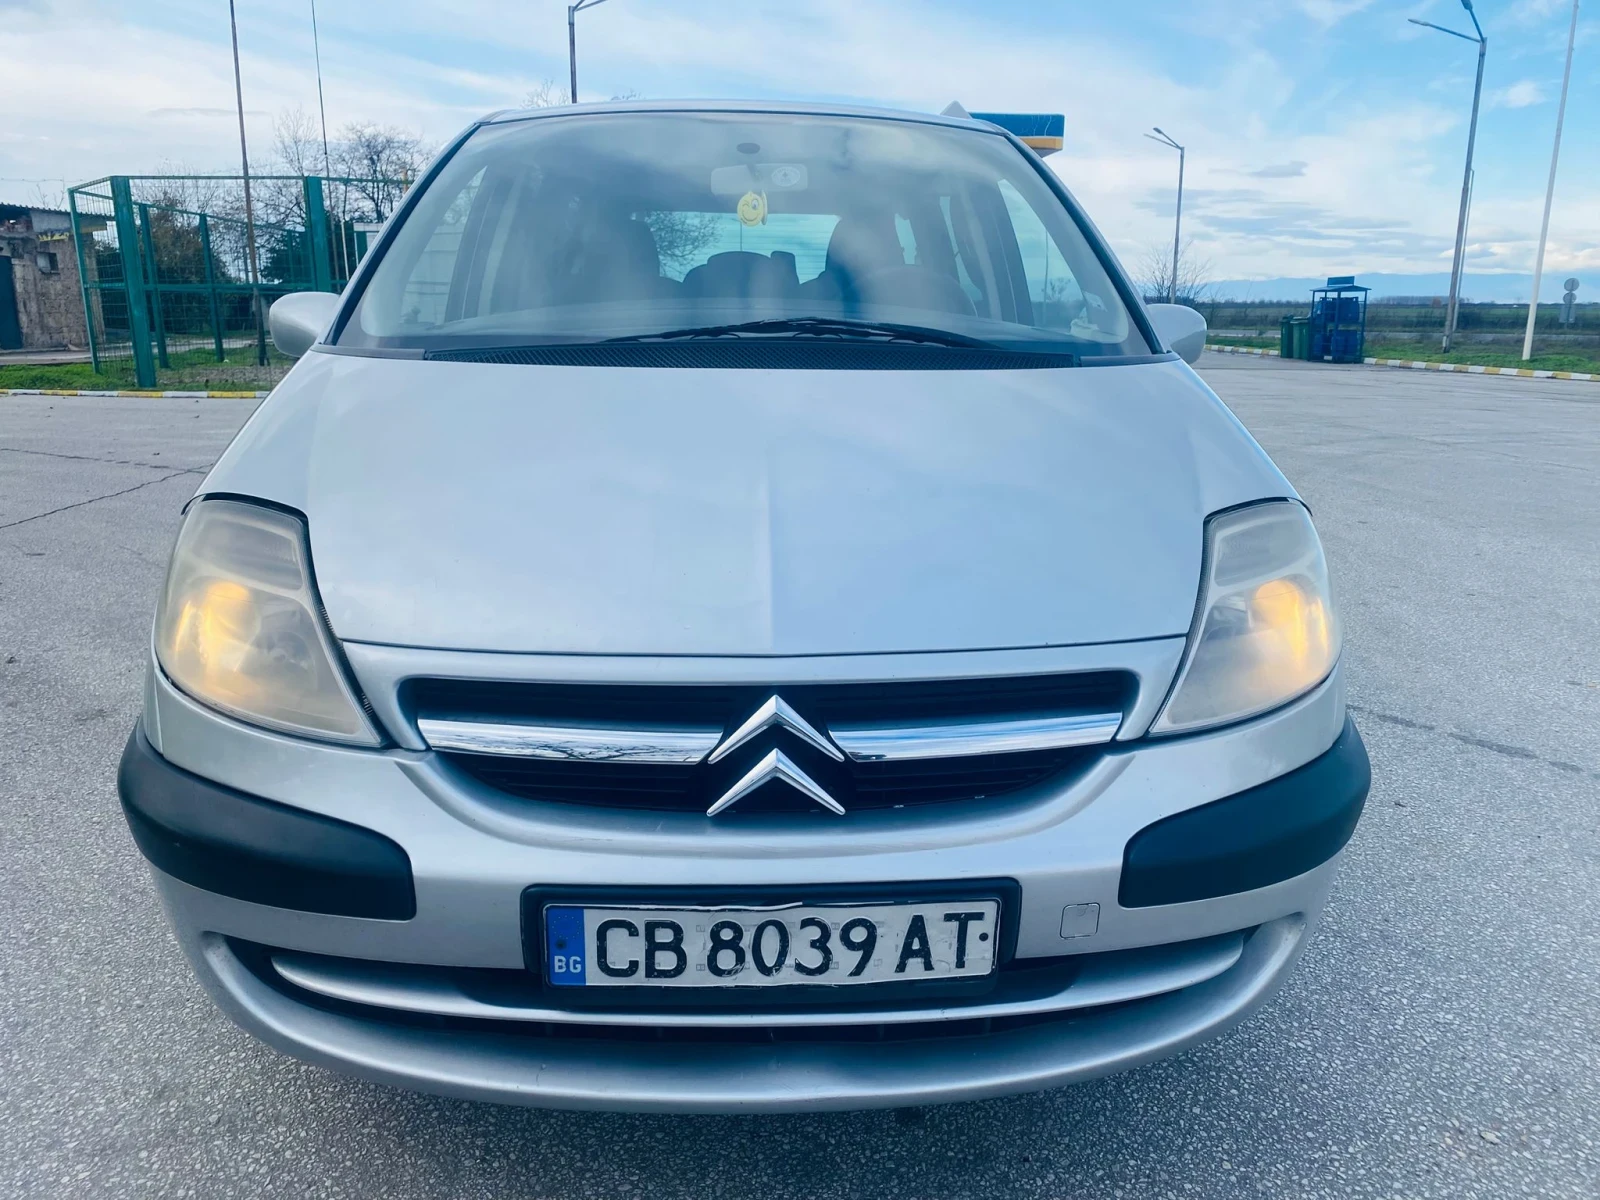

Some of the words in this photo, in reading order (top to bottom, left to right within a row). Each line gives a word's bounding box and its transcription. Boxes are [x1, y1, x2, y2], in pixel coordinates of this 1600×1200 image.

[553, 955, 582, 973] BG
[596, 918, 688, 980] CB
[706, 917, 878, 978] 8039
[895, 911, 985, 973] AT
